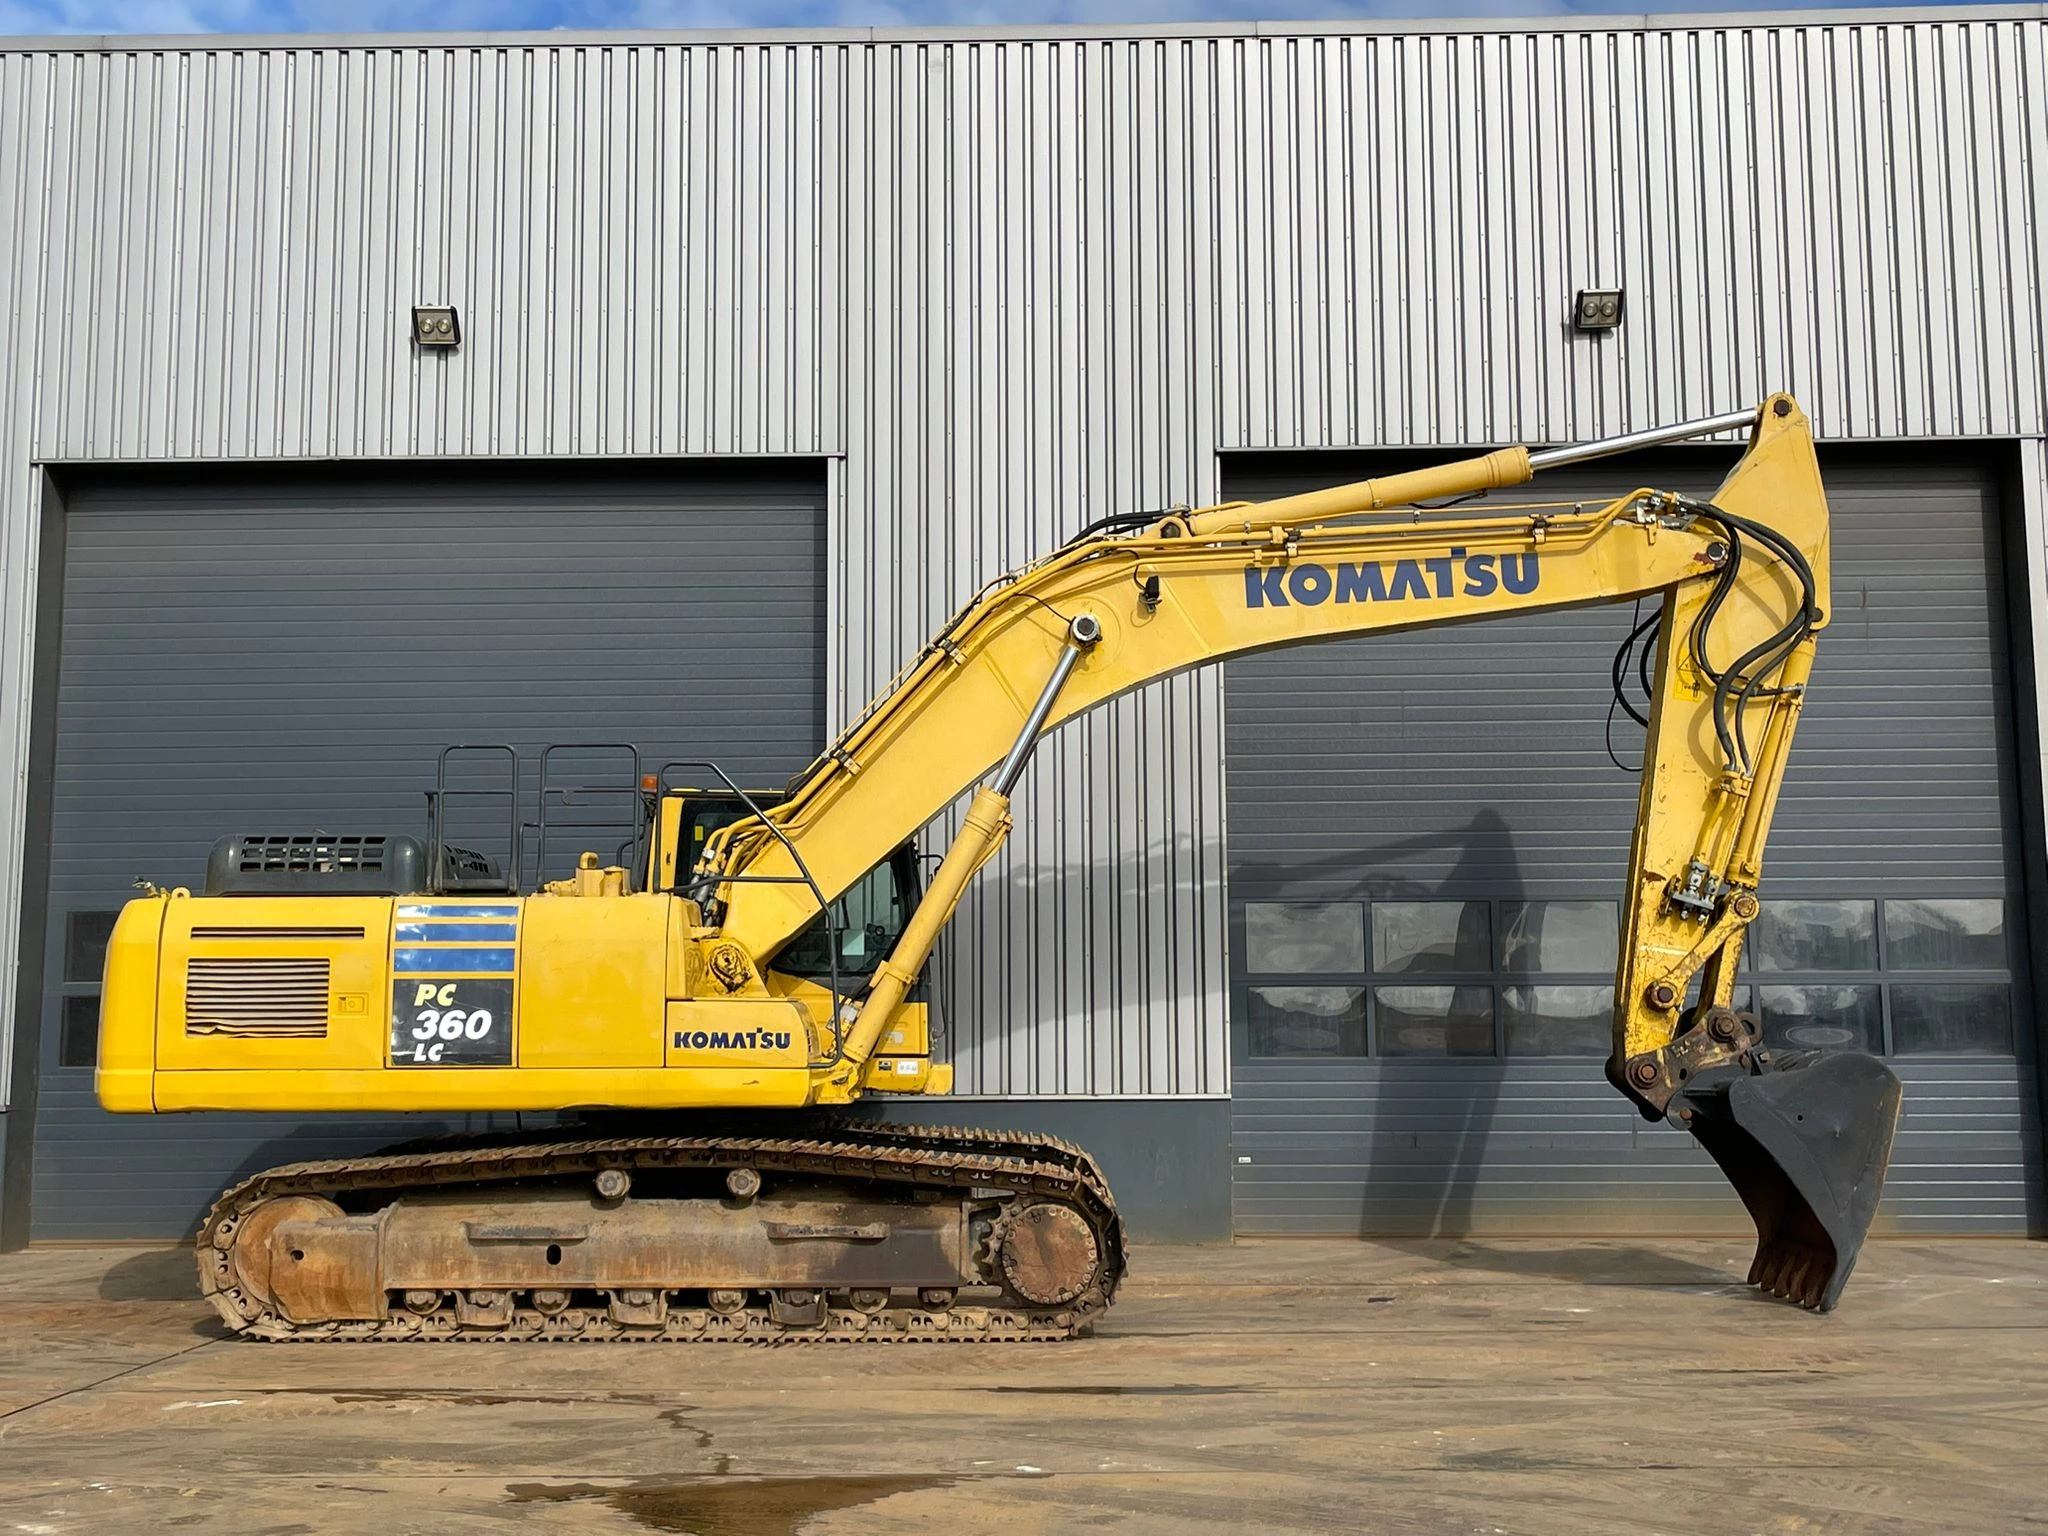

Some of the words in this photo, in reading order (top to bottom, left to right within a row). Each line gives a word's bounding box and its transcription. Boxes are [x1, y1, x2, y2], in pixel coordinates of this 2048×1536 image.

[1244, 546, 1540, 608] KOMATSU
[413, 983, 457, 1007] PC
[411, 1009, 492, 1040] 360
[674, 1027, 791, 1049] KOMATSU
[413, 1043, 445, 1062] LC
